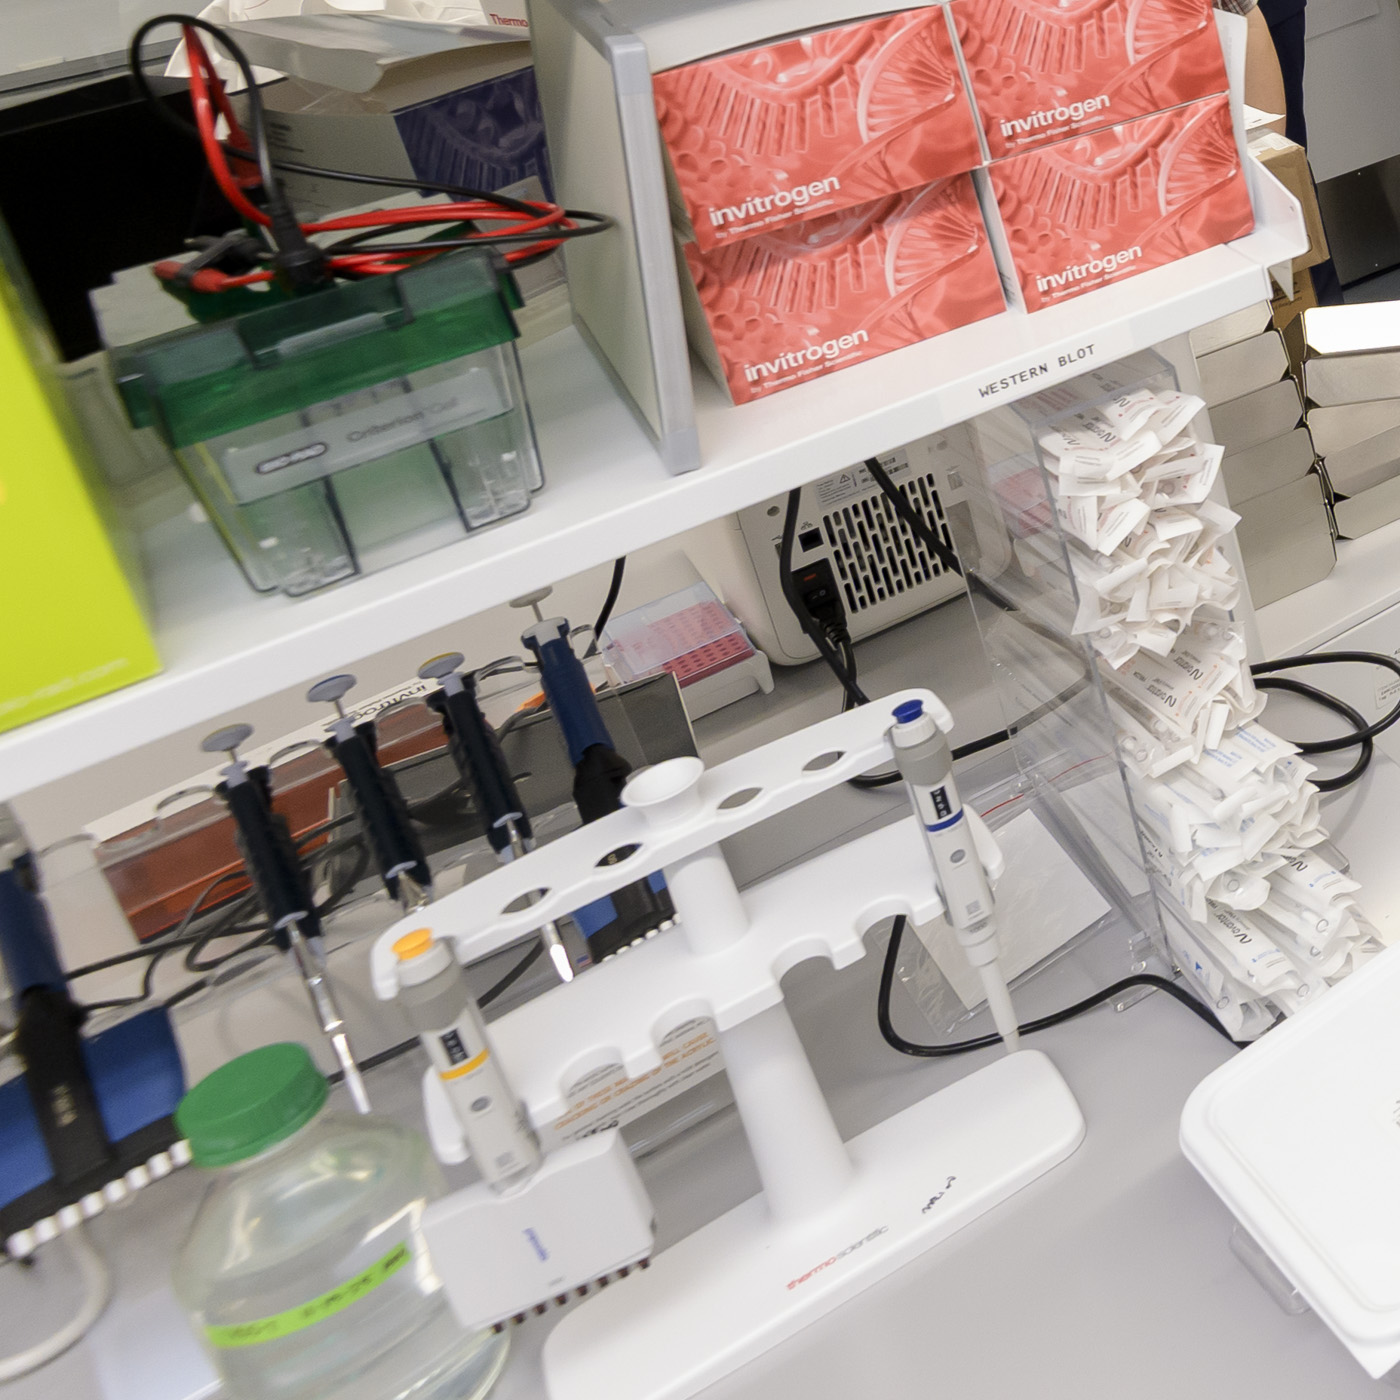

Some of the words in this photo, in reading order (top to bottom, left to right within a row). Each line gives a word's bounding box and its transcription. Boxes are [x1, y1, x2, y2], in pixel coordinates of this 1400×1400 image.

[489, 13, 529, 28] Thermo
[1000, 94, 1110, 137] invitrogen
[708, 176, 840, 226] invitrogen
[1035, 245, 1142, 292] invitrogen
[744, 329, 869, 382] invitrogen
[978, 363, 1049, 398] WESTERN
[1057, 344, 1095, 368] BLOT
